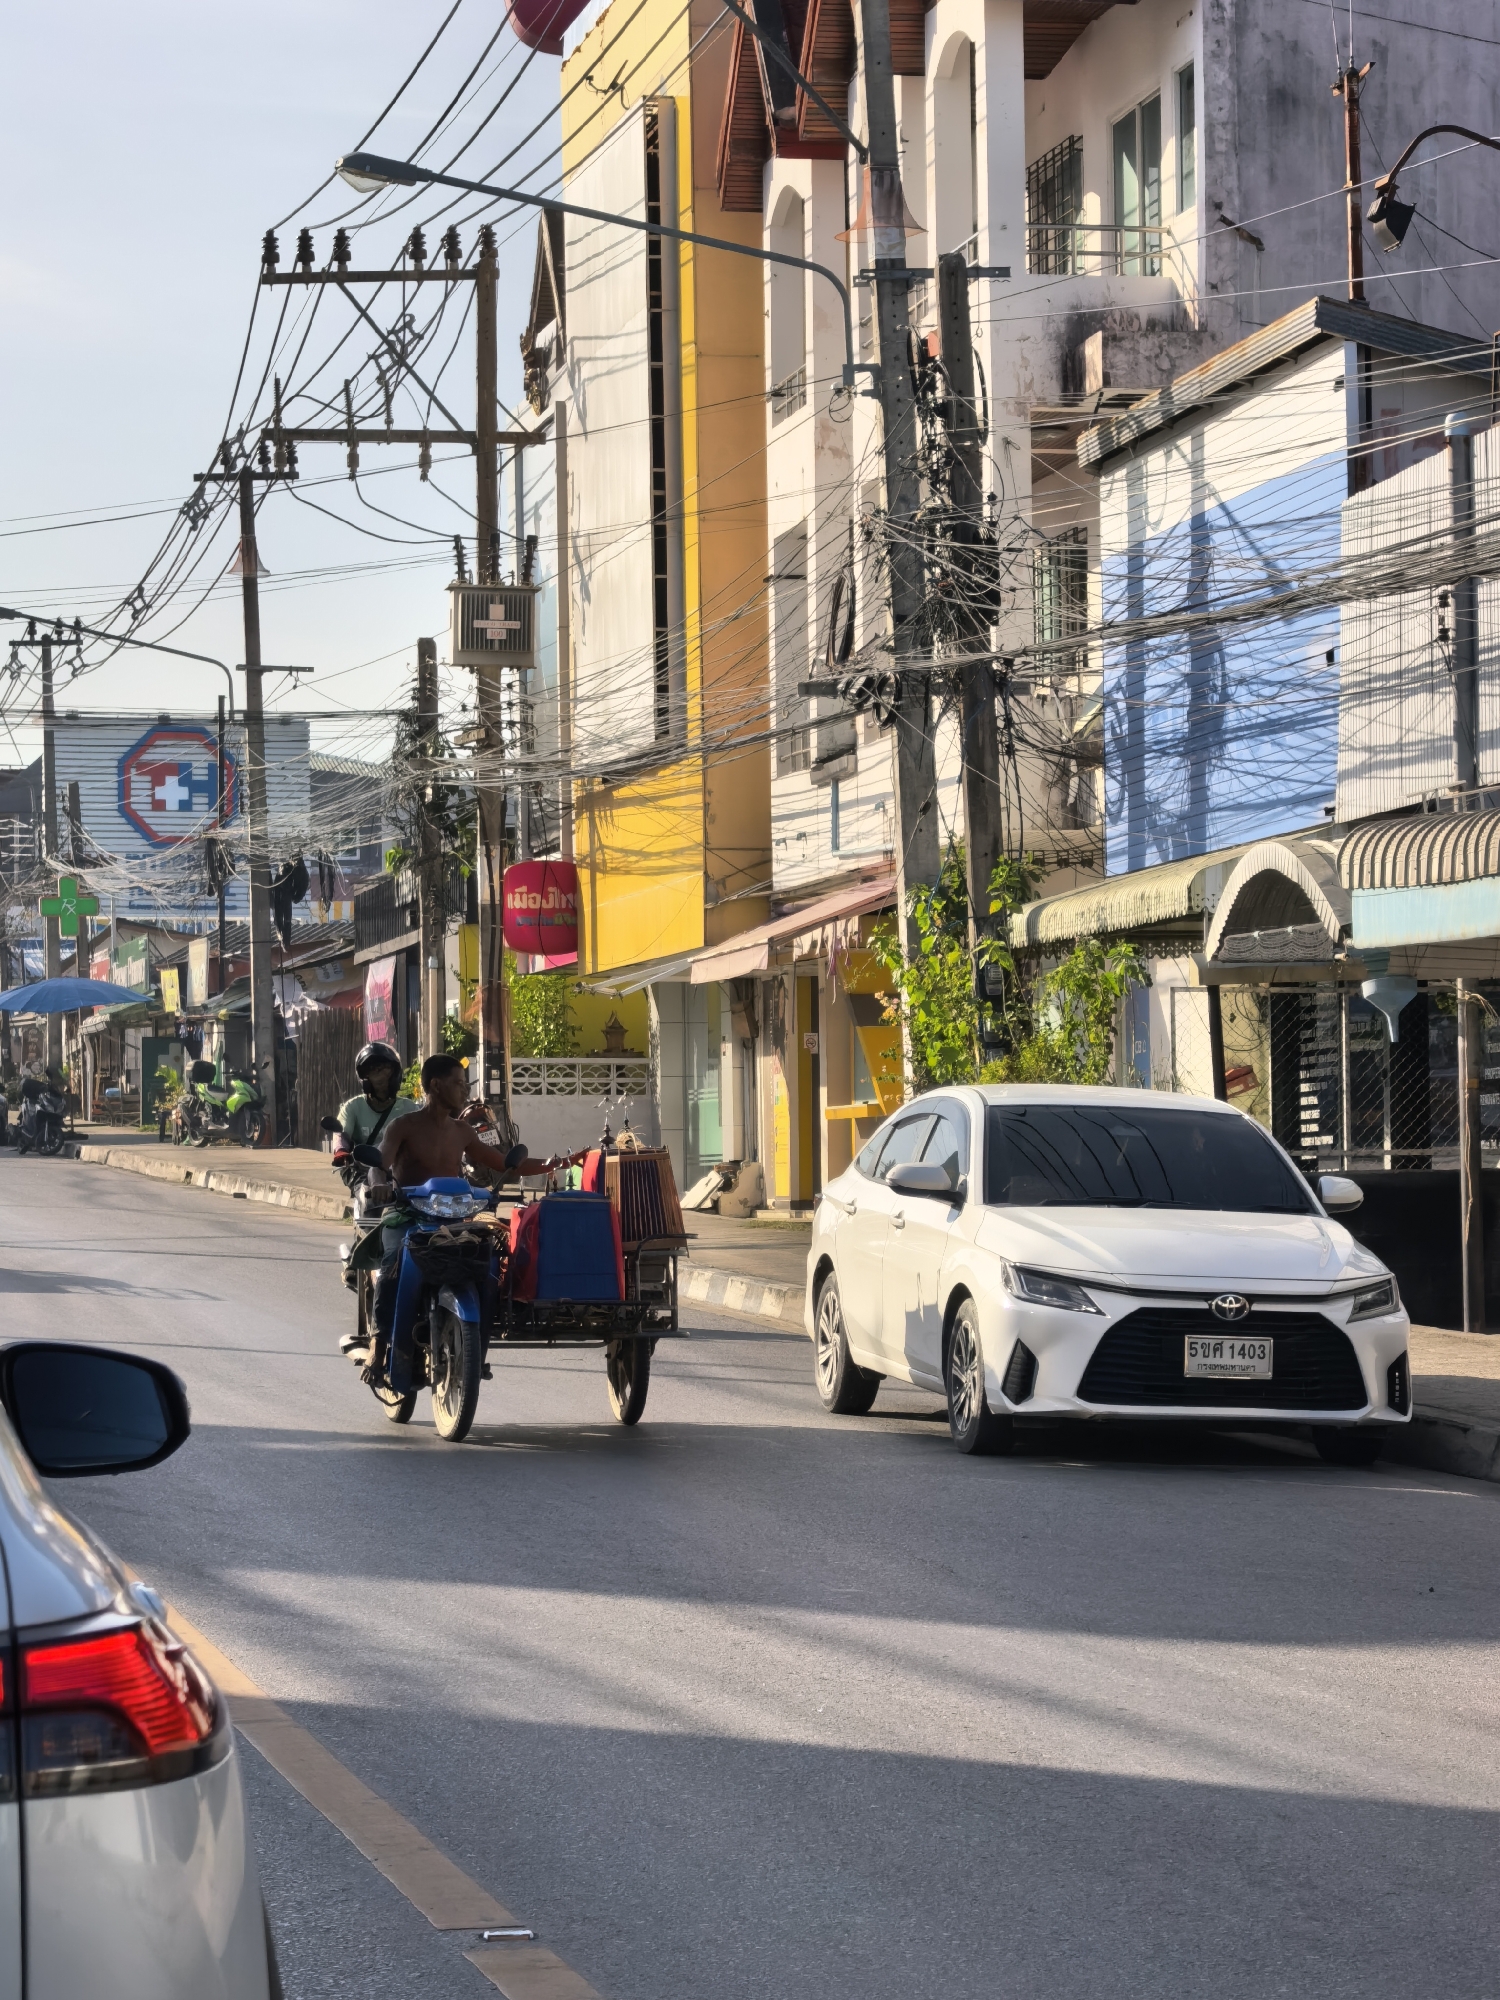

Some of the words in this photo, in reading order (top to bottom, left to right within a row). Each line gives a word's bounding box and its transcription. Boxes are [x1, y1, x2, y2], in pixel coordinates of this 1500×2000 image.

[490, 630, 504, 638] 100
[1189, 1341, 1225, 1359] 5ขศ
[1228, 1342, 1266, 1360] 1403
